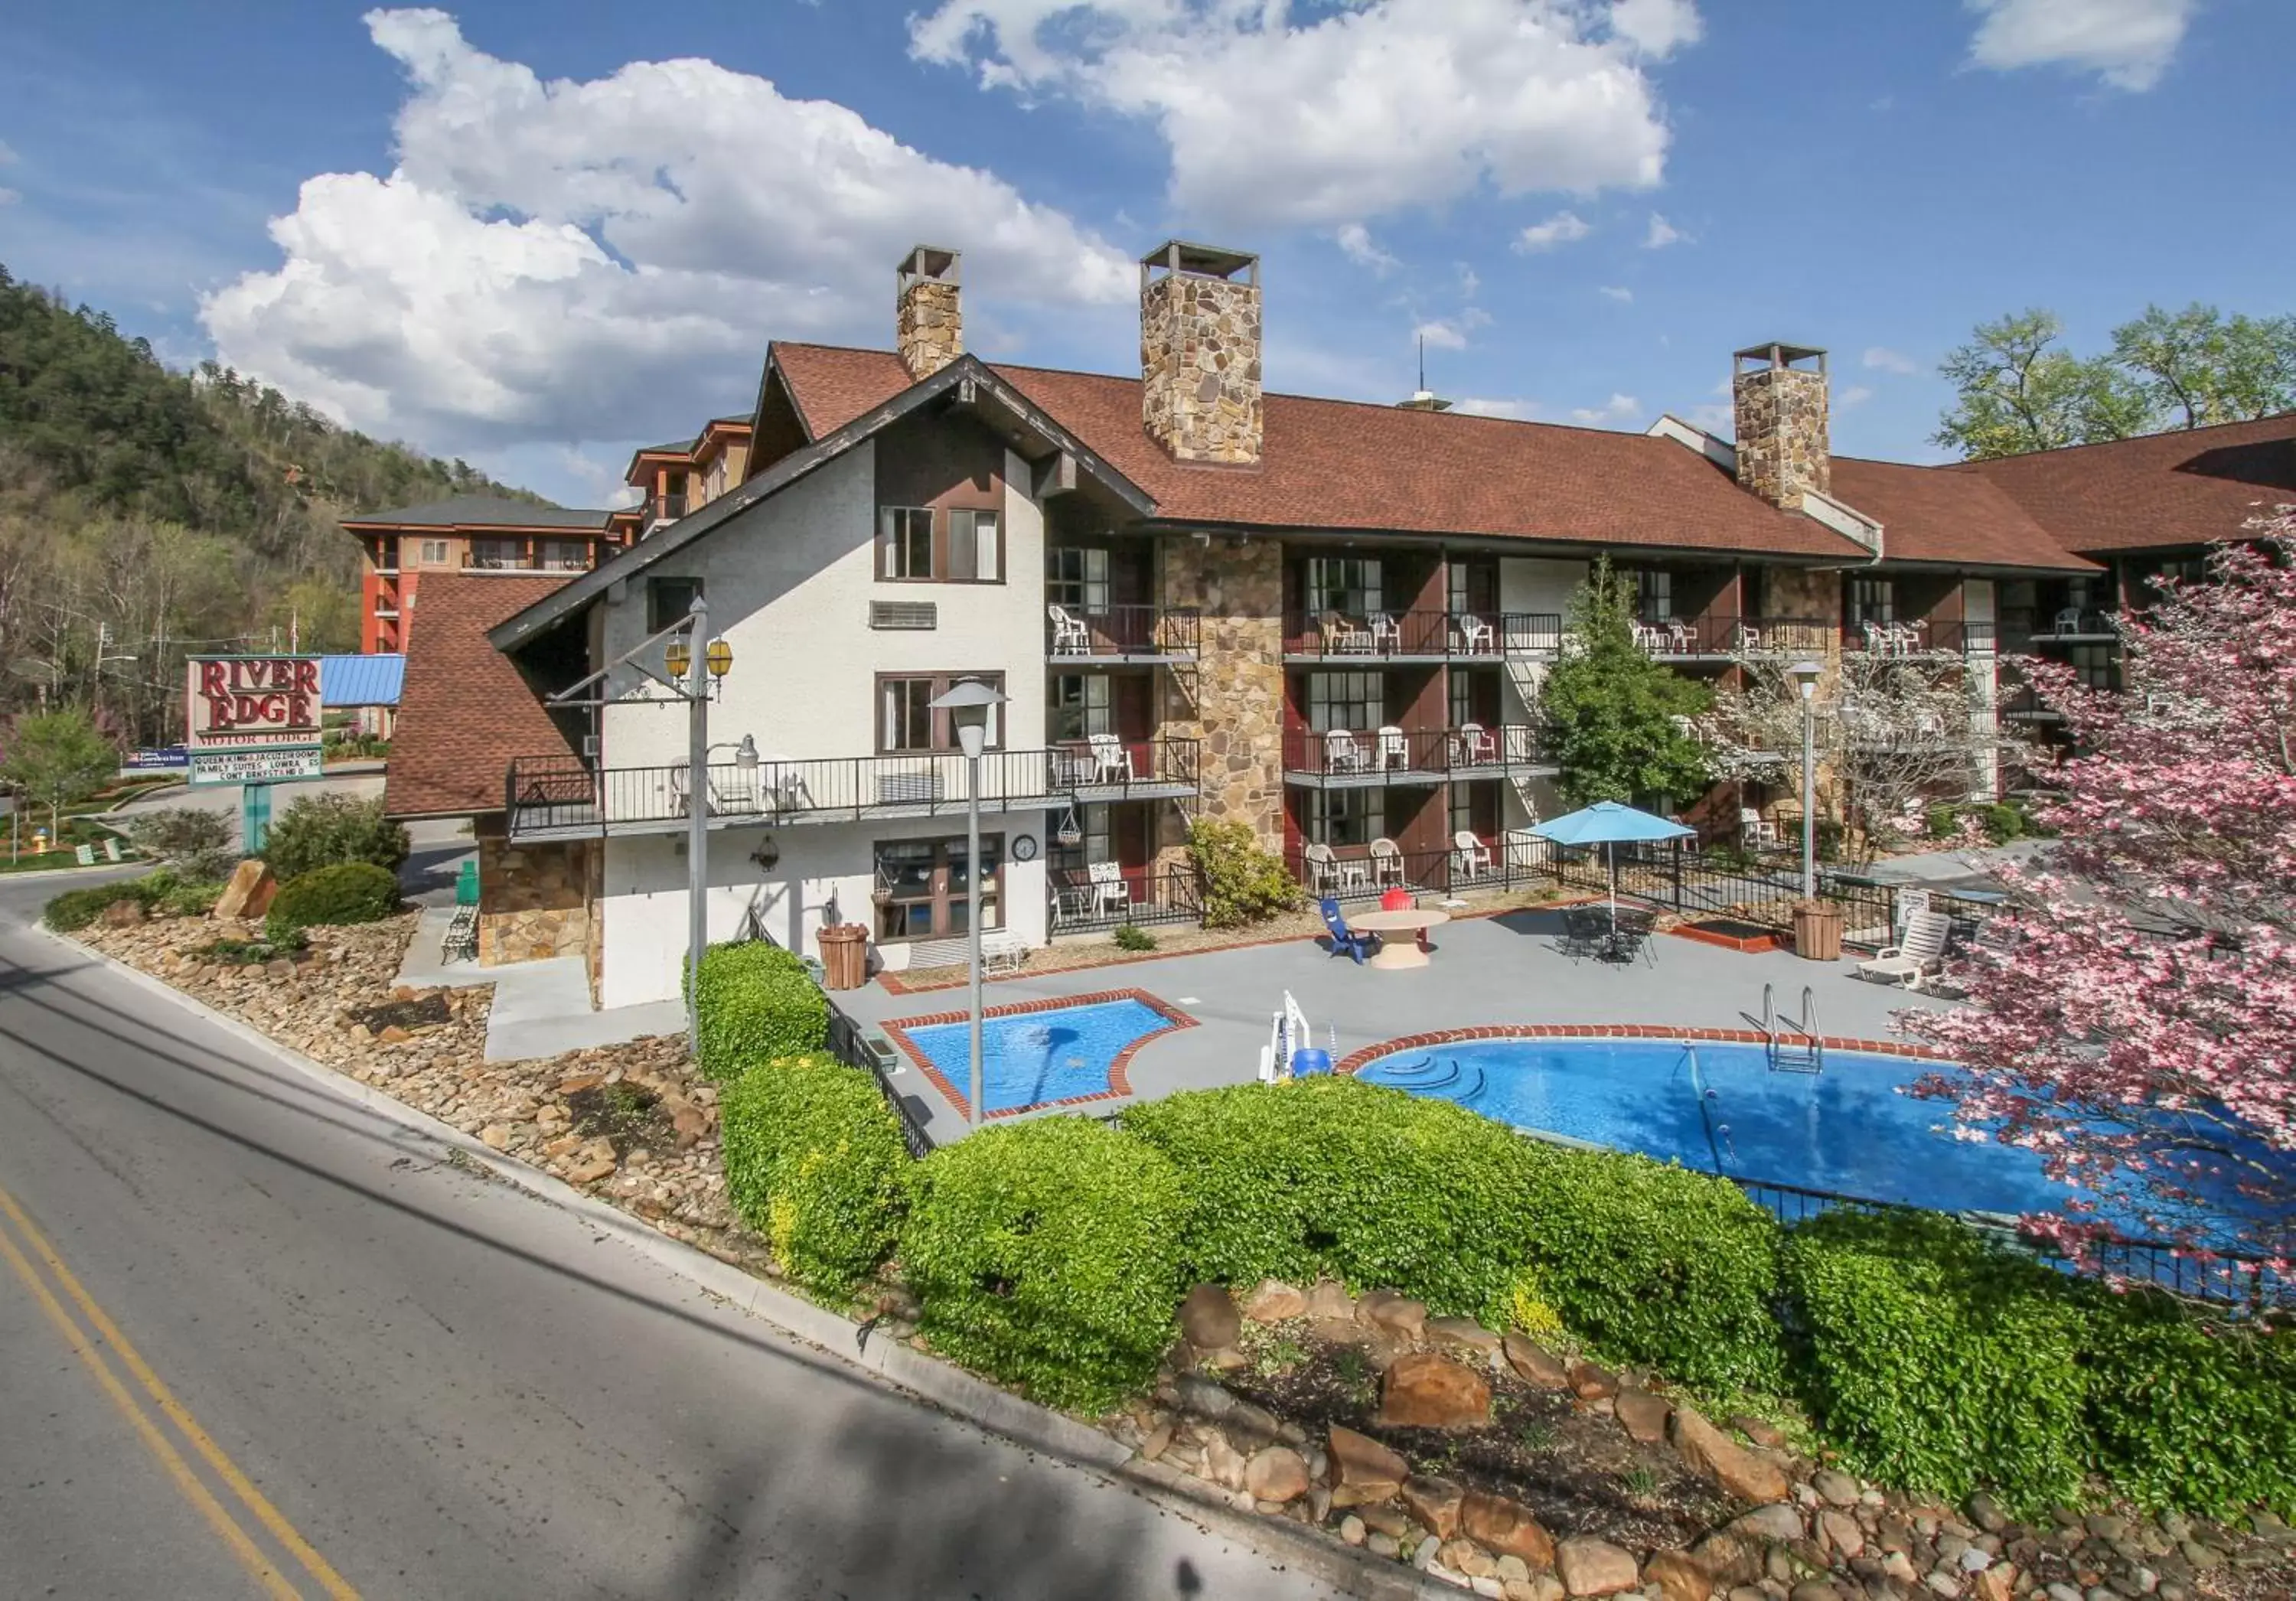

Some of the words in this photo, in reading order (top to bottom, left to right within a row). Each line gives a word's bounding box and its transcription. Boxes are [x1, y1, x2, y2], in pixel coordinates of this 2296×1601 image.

[197, 661, 320, 696] RIVER
[207, 694, 311, 730] EDGE
[198, 735, 256, 746] MOTOR
[266, 732, 316, 742] LODGE
[197, 765, 229, 774] FAMILY
[232, 762, 263, 771] SUITES
